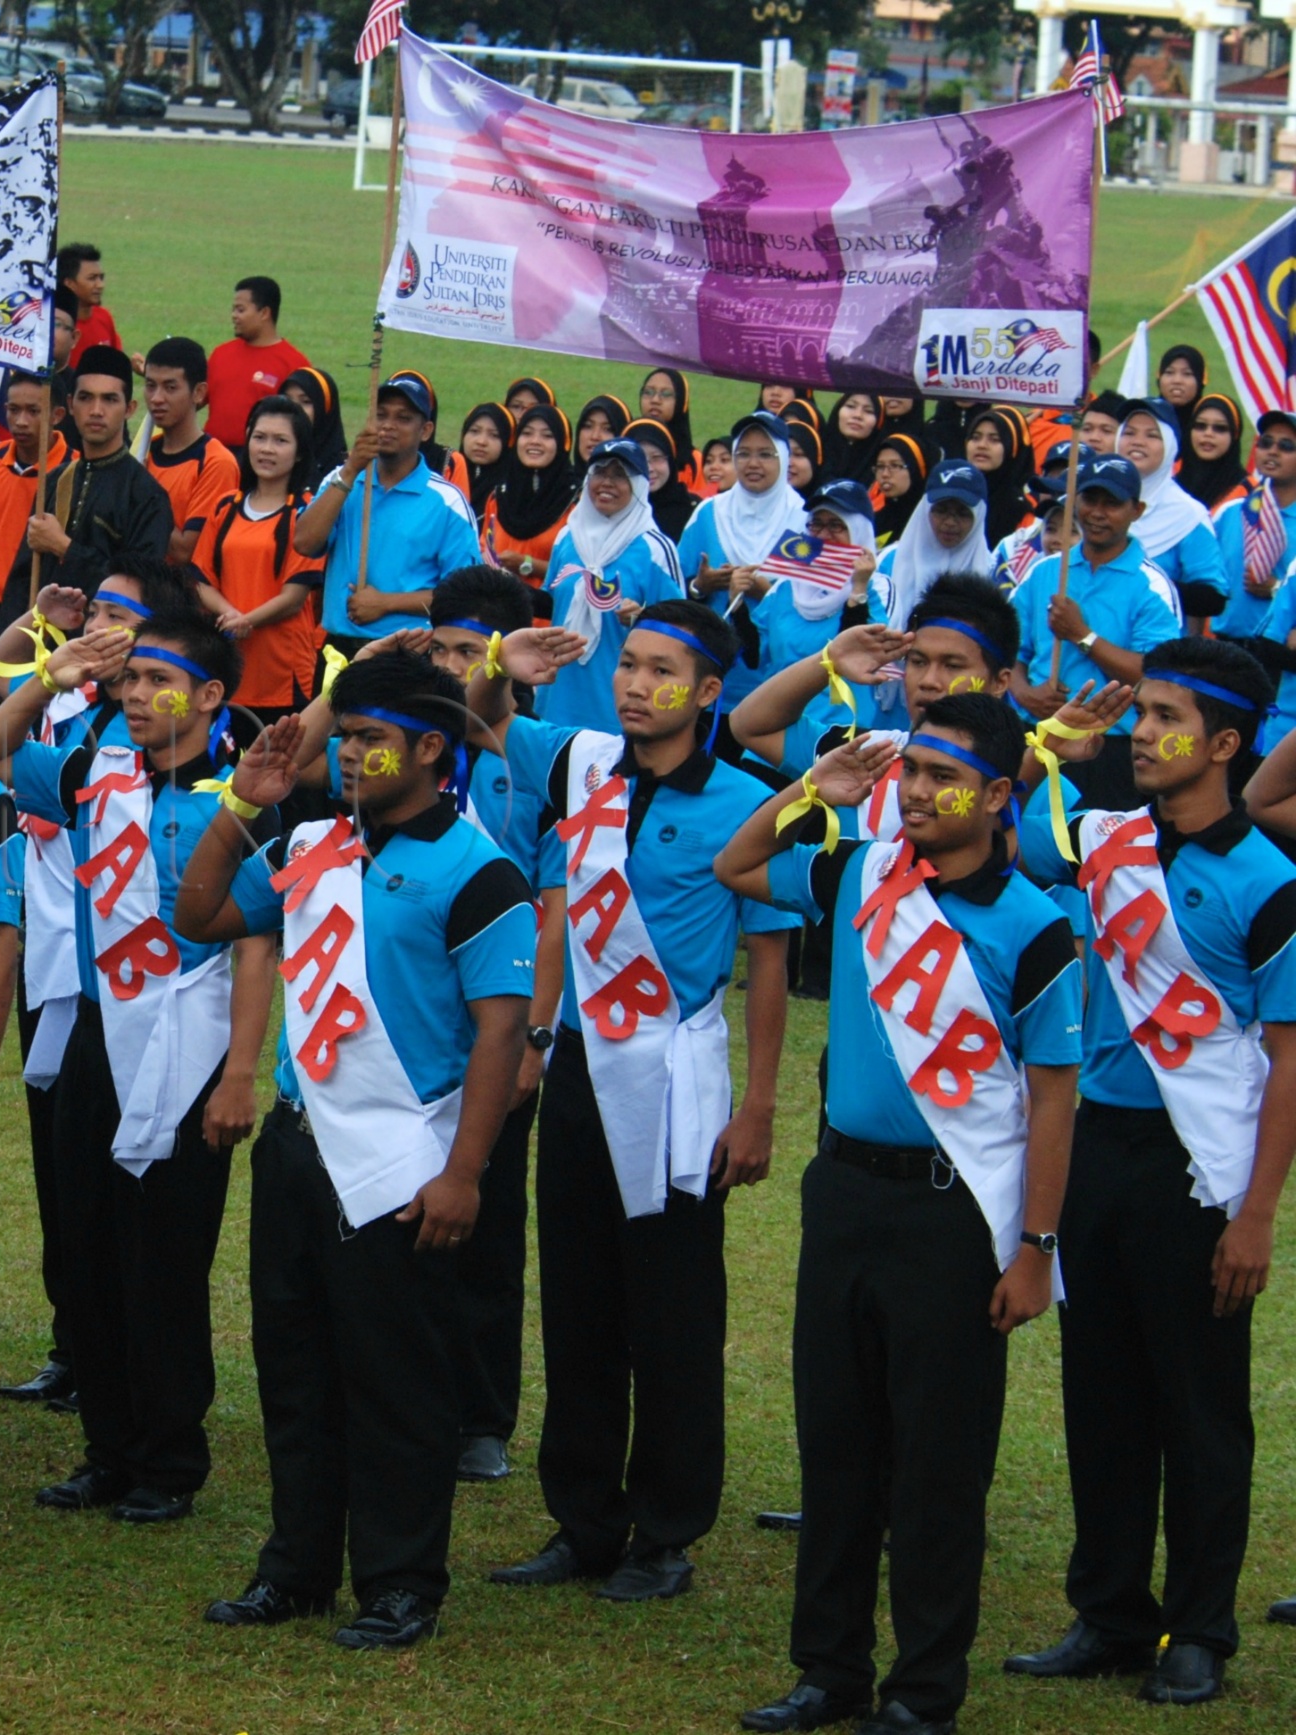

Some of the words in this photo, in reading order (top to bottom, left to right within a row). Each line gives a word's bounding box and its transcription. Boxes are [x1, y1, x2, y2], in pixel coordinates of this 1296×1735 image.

[608, 207, 685, 237] FAKULTI
[690, 222, 830, 251] PENGURUSAN
[835, 235, 886, 252] DAN
[434, 244, 507, 271] UNIVERSITI
[608, 242, 694, 269] REVOLUSI
[697, 258, 830, 284] MELESTARIKAN
[431, 261, 505, 290] PENDIDIKAN
[424, 277, 469, 301] SULTAN
[473, 290, 505, 311] IDRIS
[970, 327, 1016, 359] 55
[951, 376, 991, 394] Janji
[996, 376, 1059, 396] Ditepati
